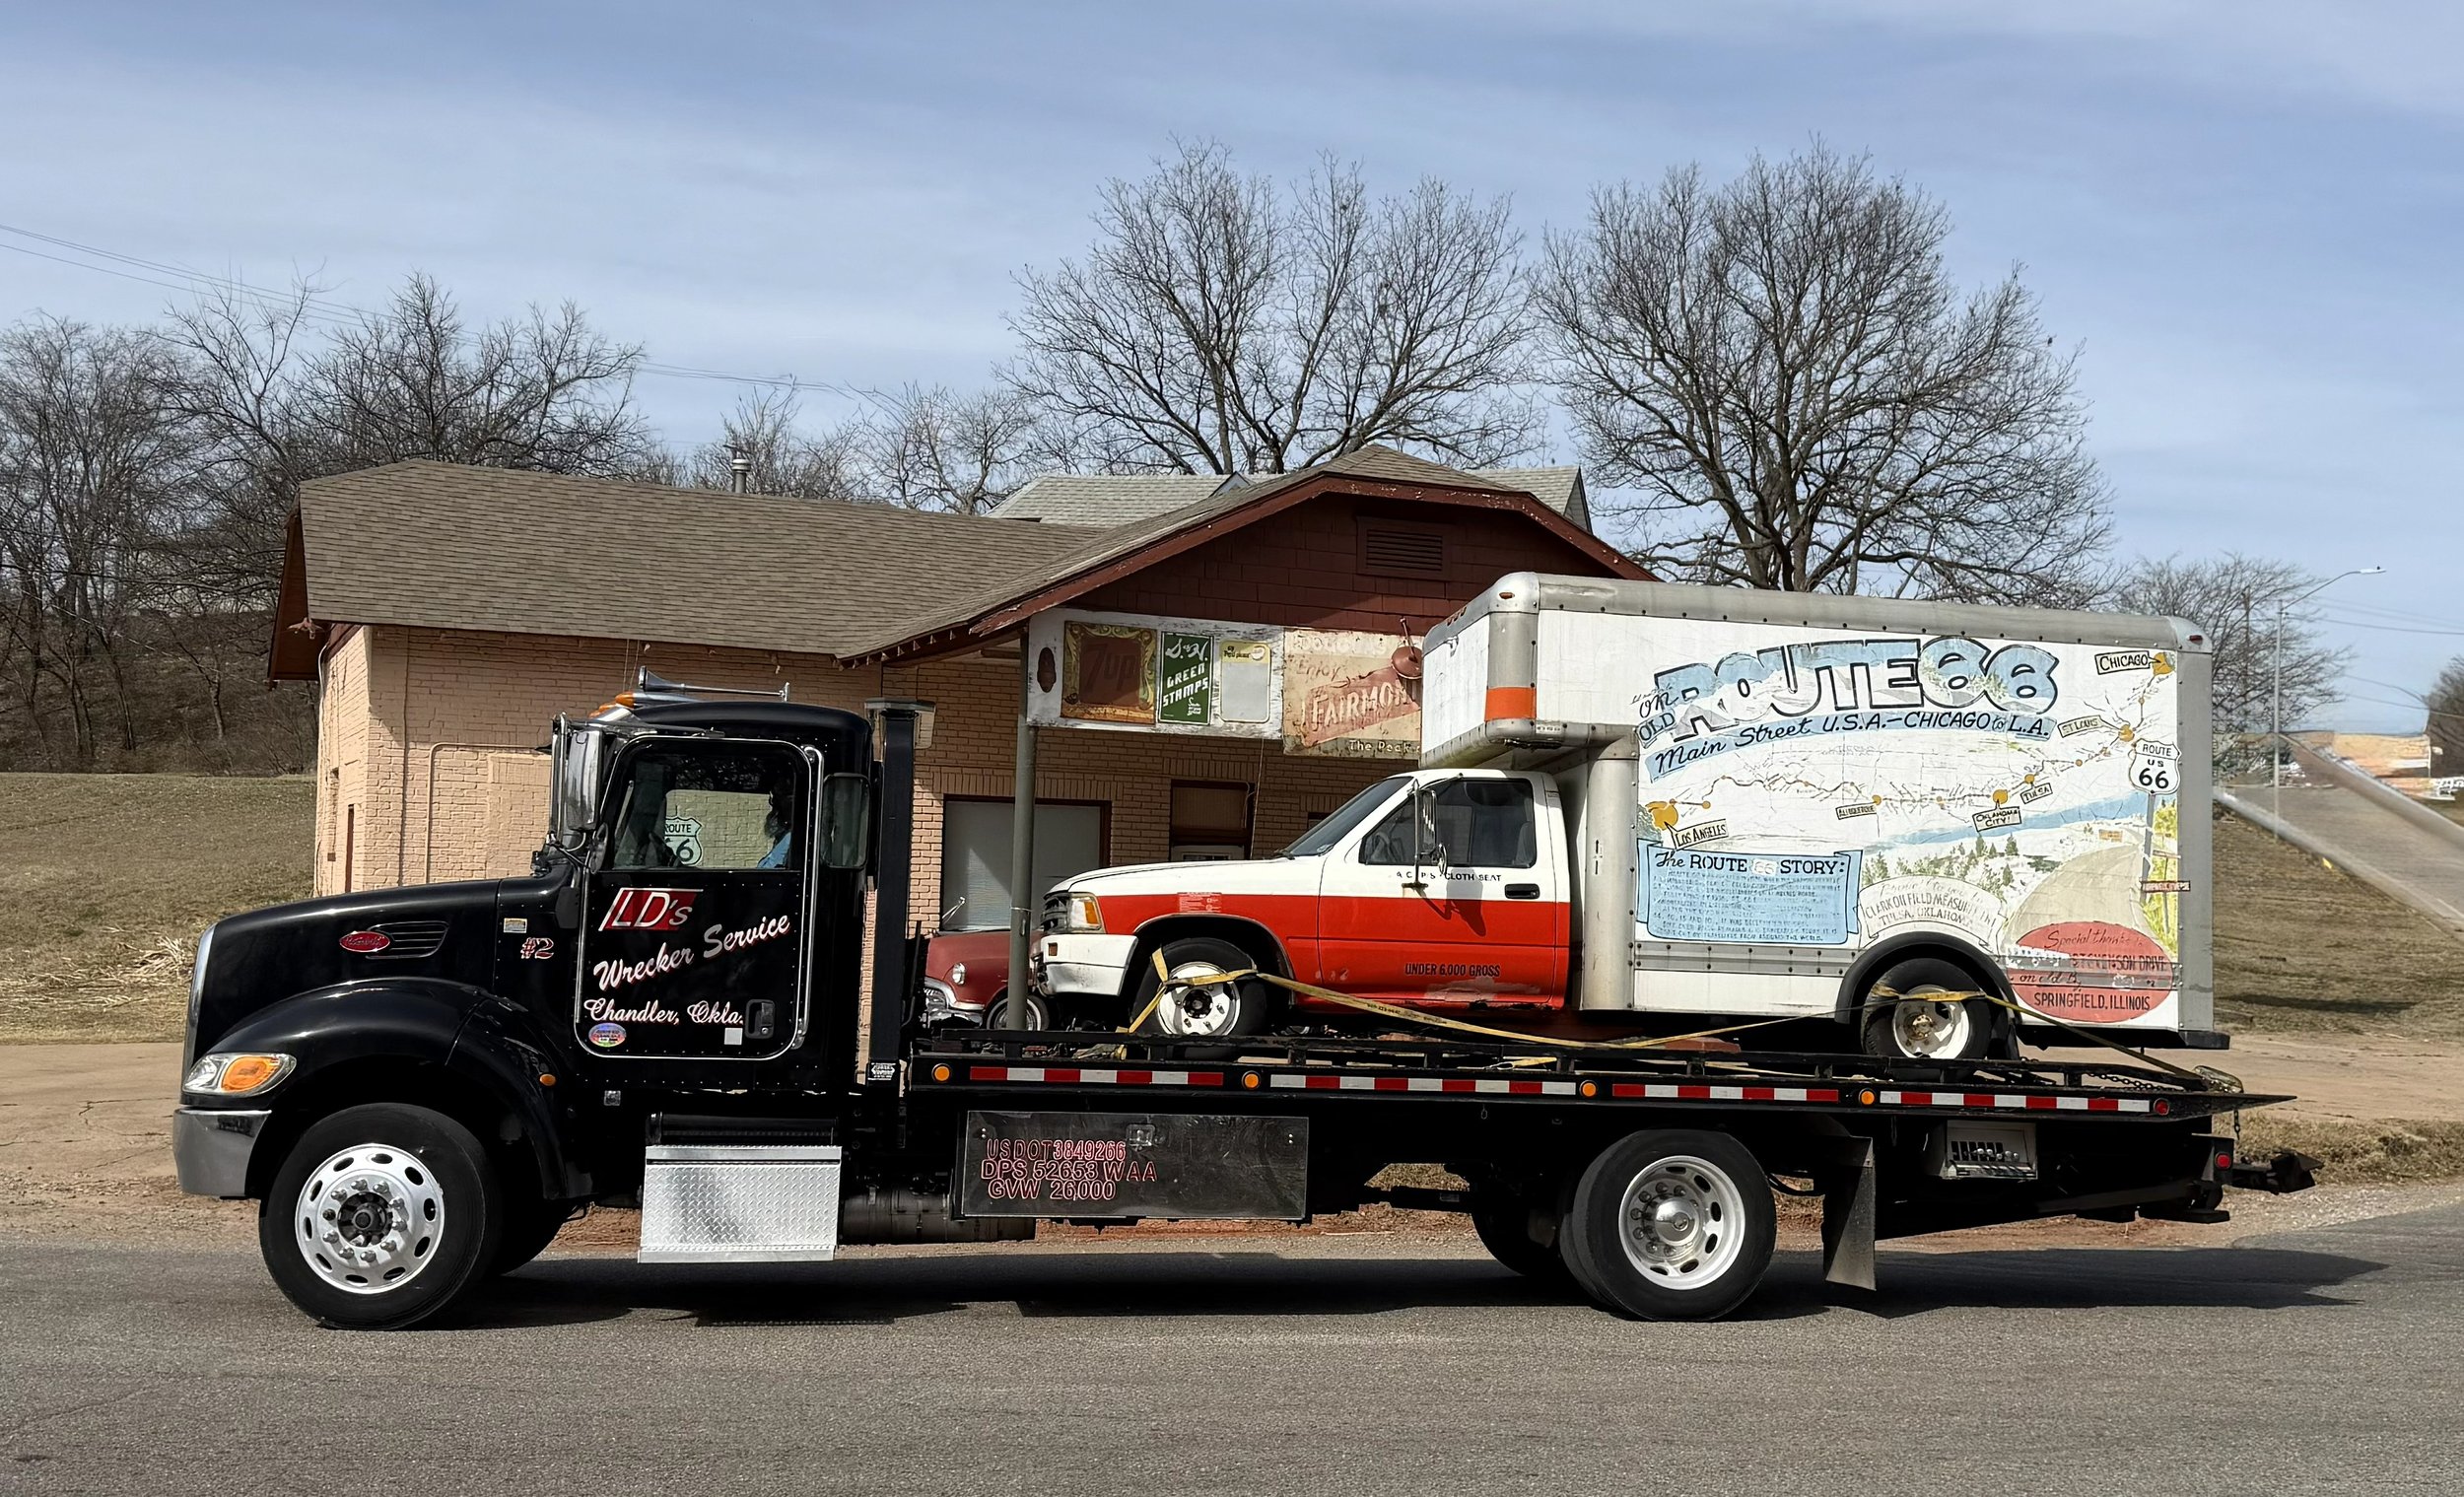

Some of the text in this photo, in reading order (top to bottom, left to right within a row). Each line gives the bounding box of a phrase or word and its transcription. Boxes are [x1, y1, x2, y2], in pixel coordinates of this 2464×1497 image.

[2099, 654, 2149, 672] CHICAGO
[1167, 662, 1205, 688] GREEN
[1162, 676, 1208, 707] STAMPS
[1653, 635, 2059, 743] ROUTE 66
[1312, 680, 1408, 730] FAIRMON
[1639, 713, 1676, 741] OLD
[1348, 740, 1409, 753] The Peak
[1655, 740, 1726, 773] Main
[1735, 717, 1813, 747] Street
[2008, 715, 2049, 736] L.A.
[2143, 743, 2171, 757] ROUTE
[2139, 768, 2169, 789] 66
[2024, 786, 2050, 801] TULSA
[1976, 809, 2019, 822] OKLAHOMA
[1676, 824, 1726, 847] LOS ANGELES
[665, 838, 694, 862] 6
[1655, 849, 1845, 875] The ROUTE 66 STORY:
[611, 891, 693, 927] LD's
[520, 937, 554, 959] #2
[2043, 928, 2088, 952] Special
[593, 915, 790, 991] Wrecker Service
[2139, 955, 2166, 972] DRIVE
[1404, 963, 1437, 976] UNDER
[1469, 965, 1501, 978] GROSS
[583, 997, 744, 1026] Chandler, Okla.
[2110, 994, 2151, 1011] ILLINOIS
[981, 1158, 1028, 1180] DPS
[1033, 1160, 1099, 1181] 52653
[988, 1179, 1042, 1199] GVW
